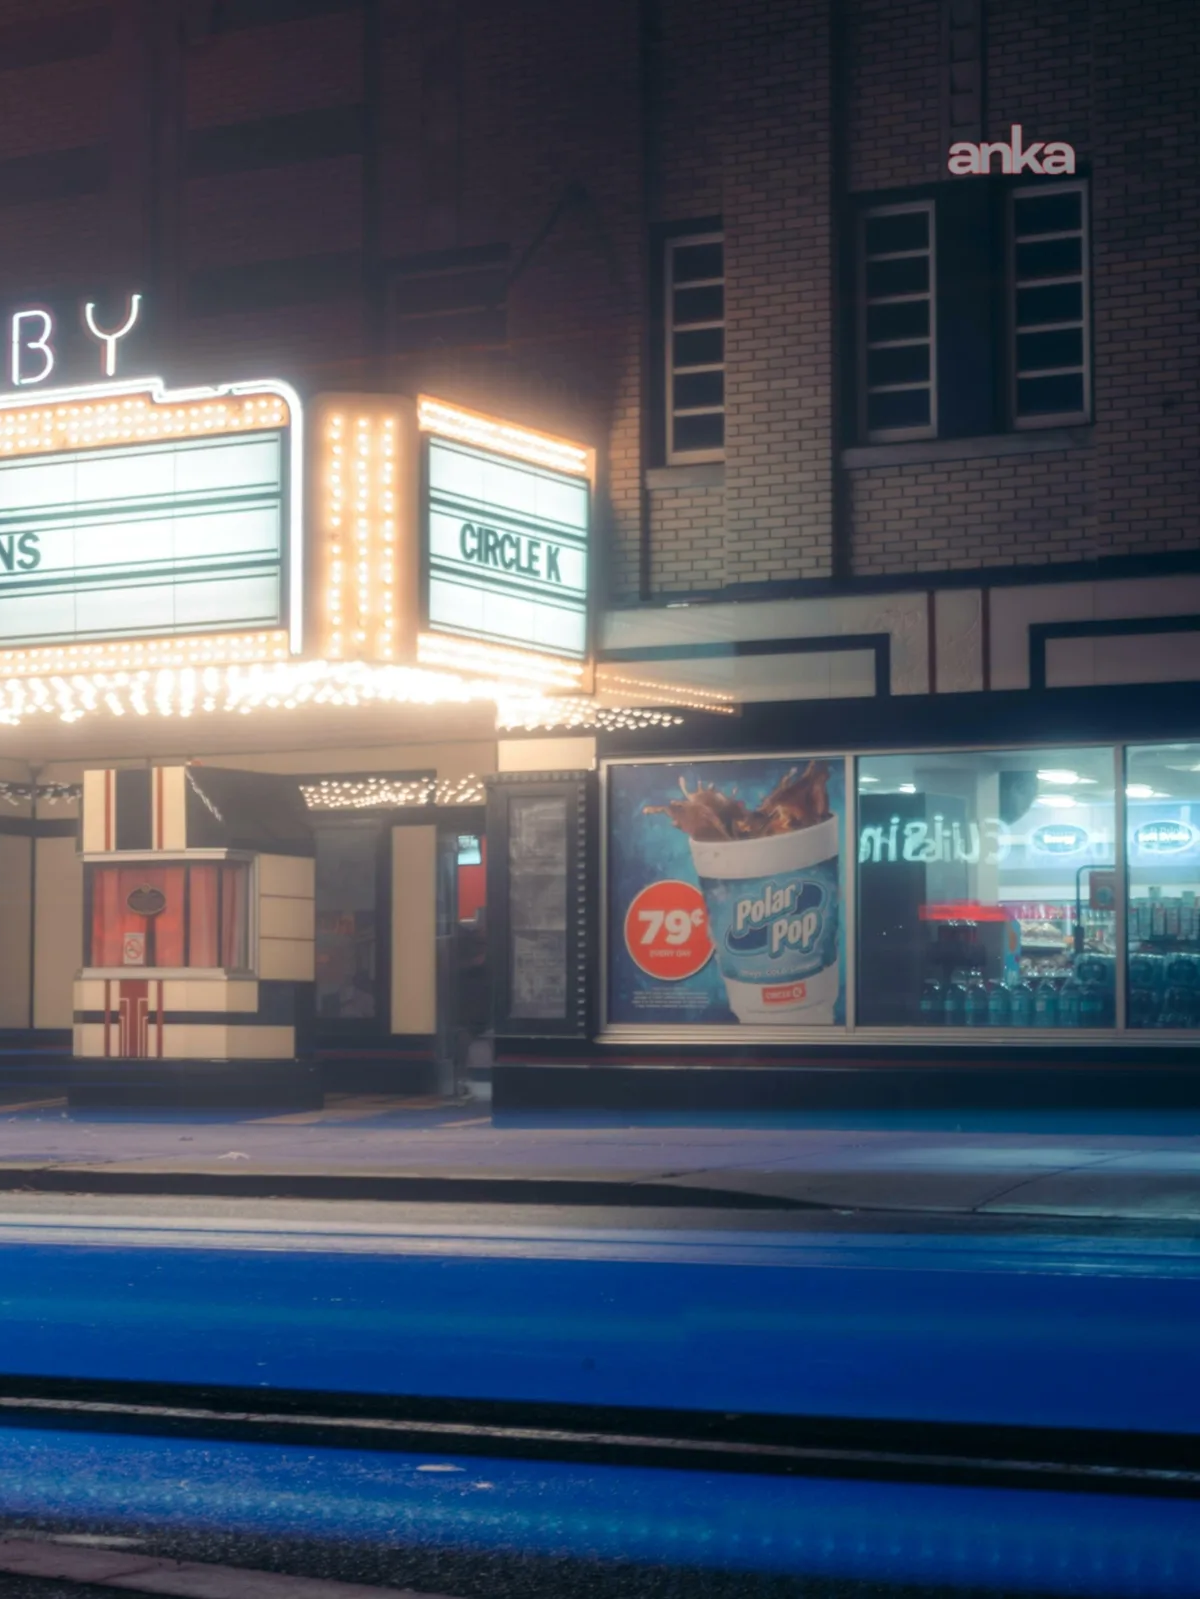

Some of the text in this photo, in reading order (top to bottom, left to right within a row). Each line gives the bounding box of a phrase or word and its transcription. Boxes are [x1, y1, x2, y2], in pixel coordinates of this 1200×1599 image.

[460, 523, 562, 583] CIRCLE K
[736, 882, 796, 931] Polar
[649, 949, 692, 959] EVERY DAY
[772, 913, 818, 953] Pop
